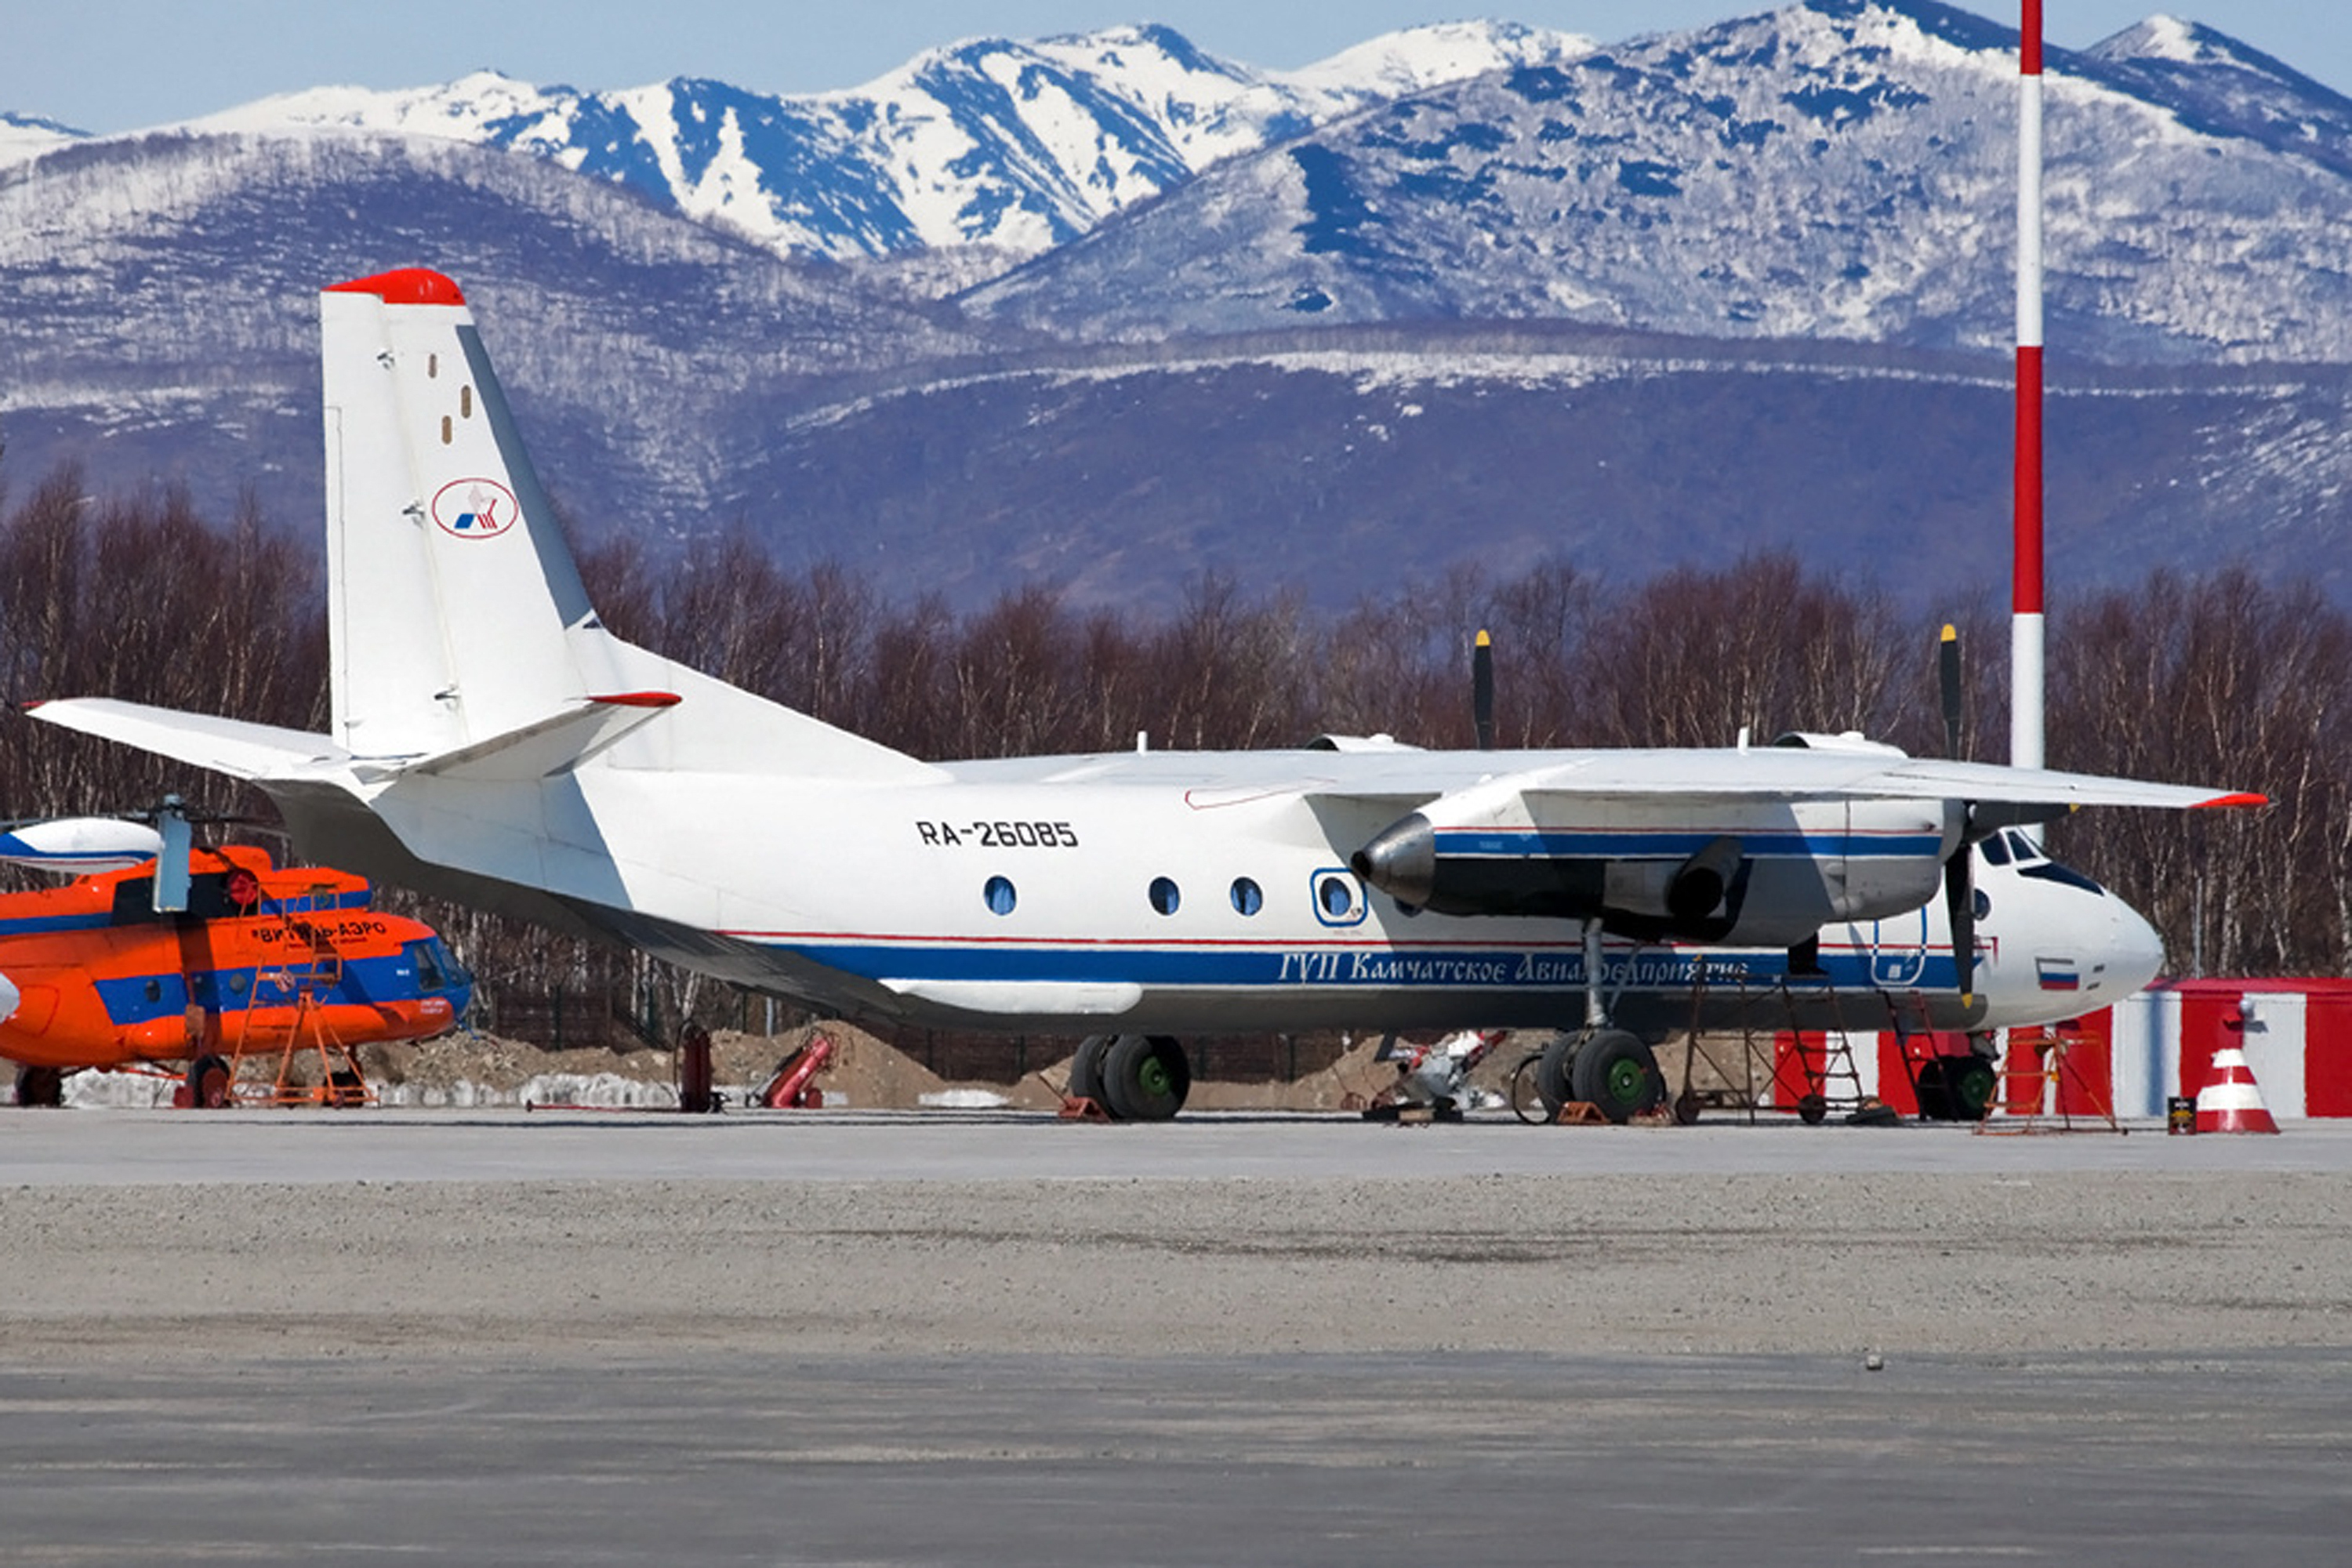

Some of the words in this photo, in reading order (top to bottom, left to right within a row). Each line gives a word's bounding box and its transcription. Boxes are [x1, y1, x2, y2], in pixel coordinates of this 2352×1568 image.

[916, 820, 1079, 848] RA-26085
[1278, 952, 1341, 984] ГУП
[1350, 952, 1507, 982] Камчатское
